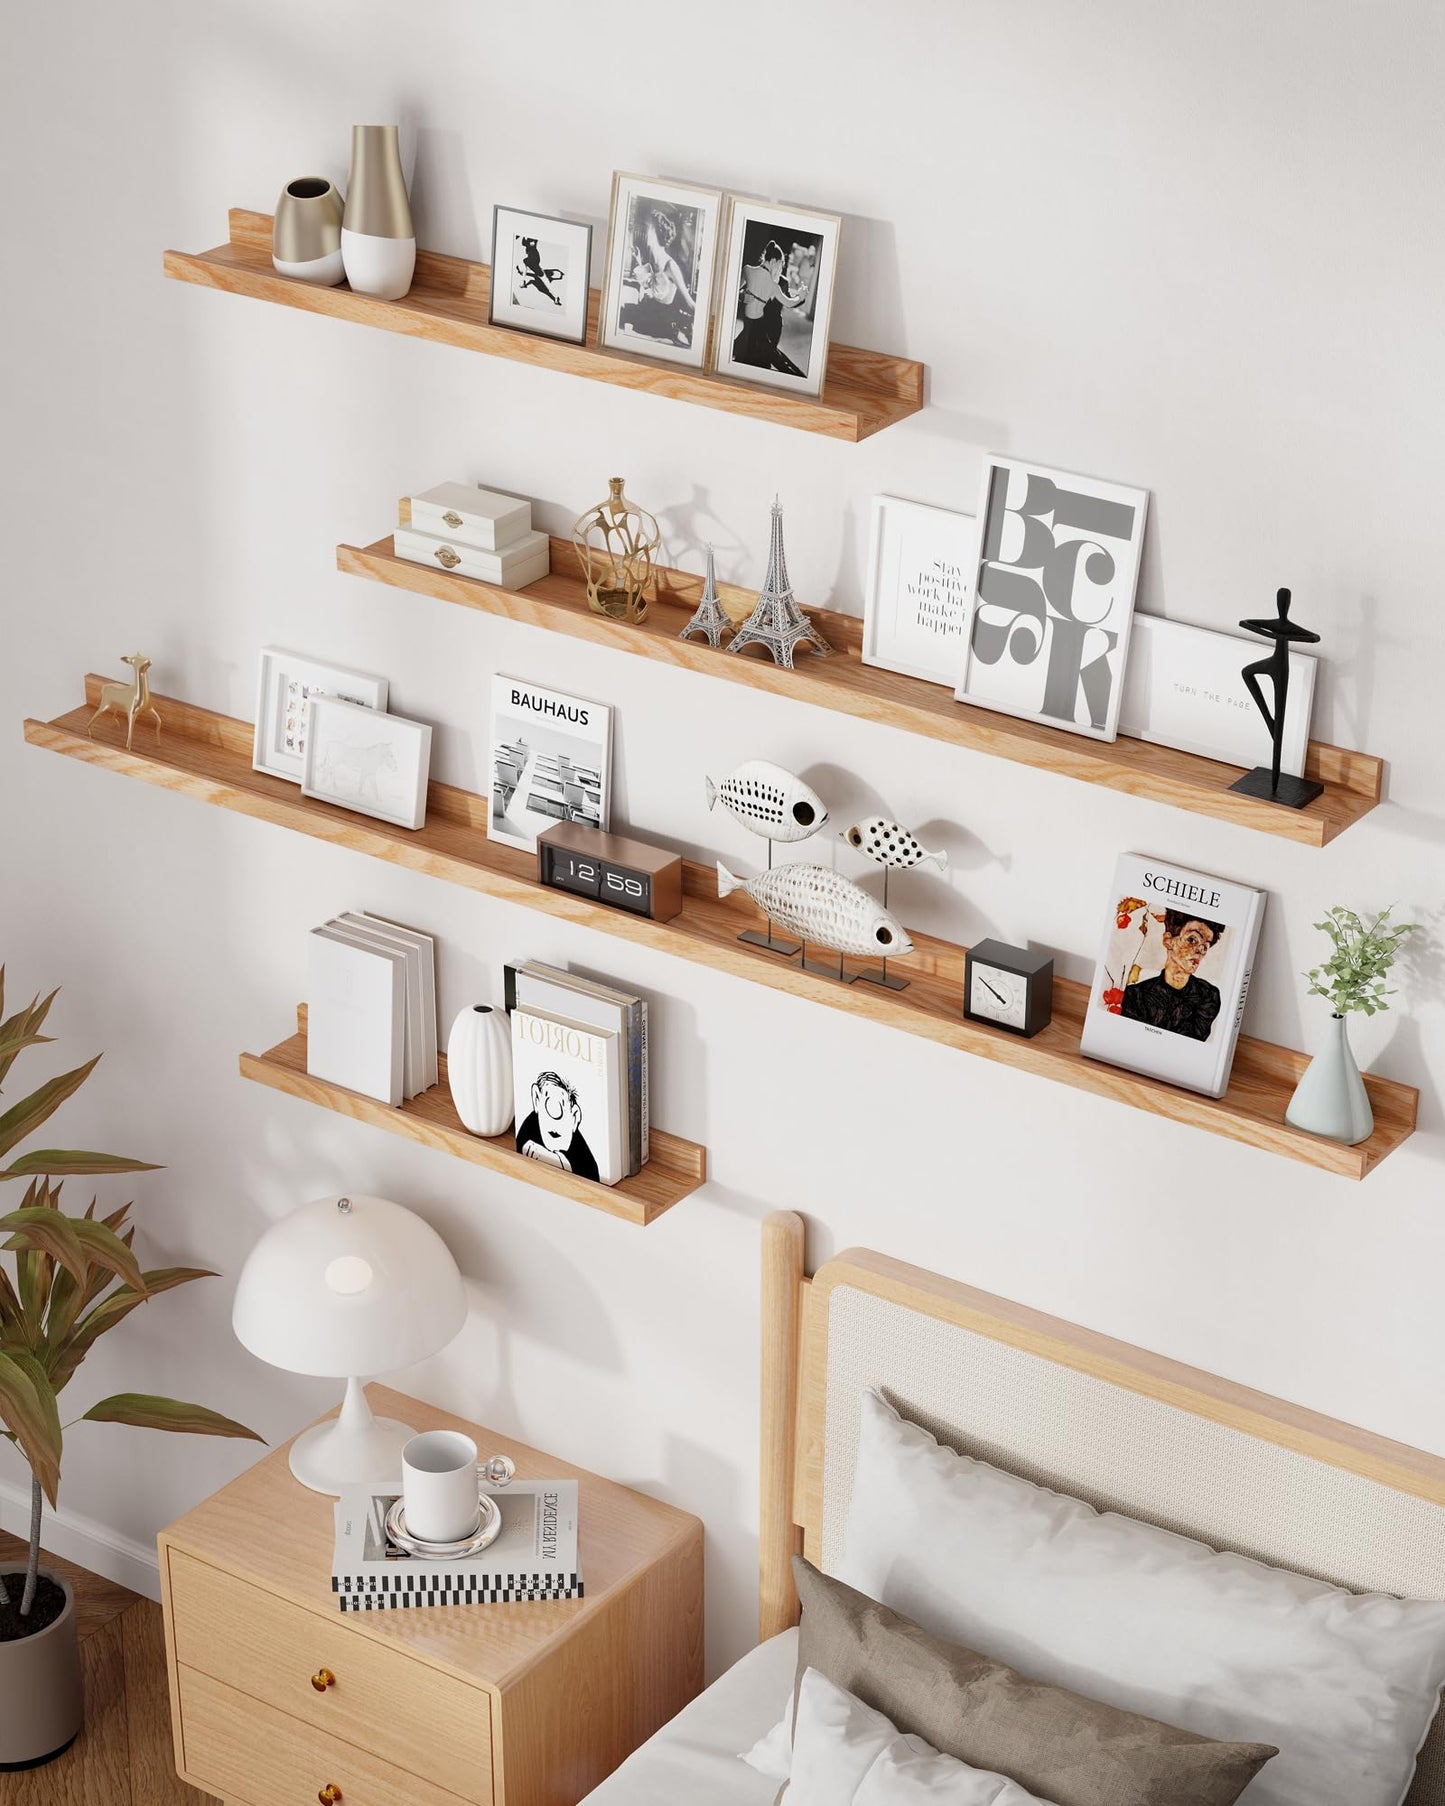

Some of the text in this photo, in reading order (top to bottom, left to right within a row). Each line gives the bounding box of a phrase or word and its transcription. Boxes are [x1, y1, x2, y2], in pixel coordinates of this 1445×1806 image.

[908, 583, 941, 601] work
[920, 601, 957, 617] make
[511, 689, 589, 726] BAUHAUS
[1204, 691, 1220, 703] THE
[1227, 697, 1251, 711] PAGE
[1142, 872, 1221, 908] SCHIELE
